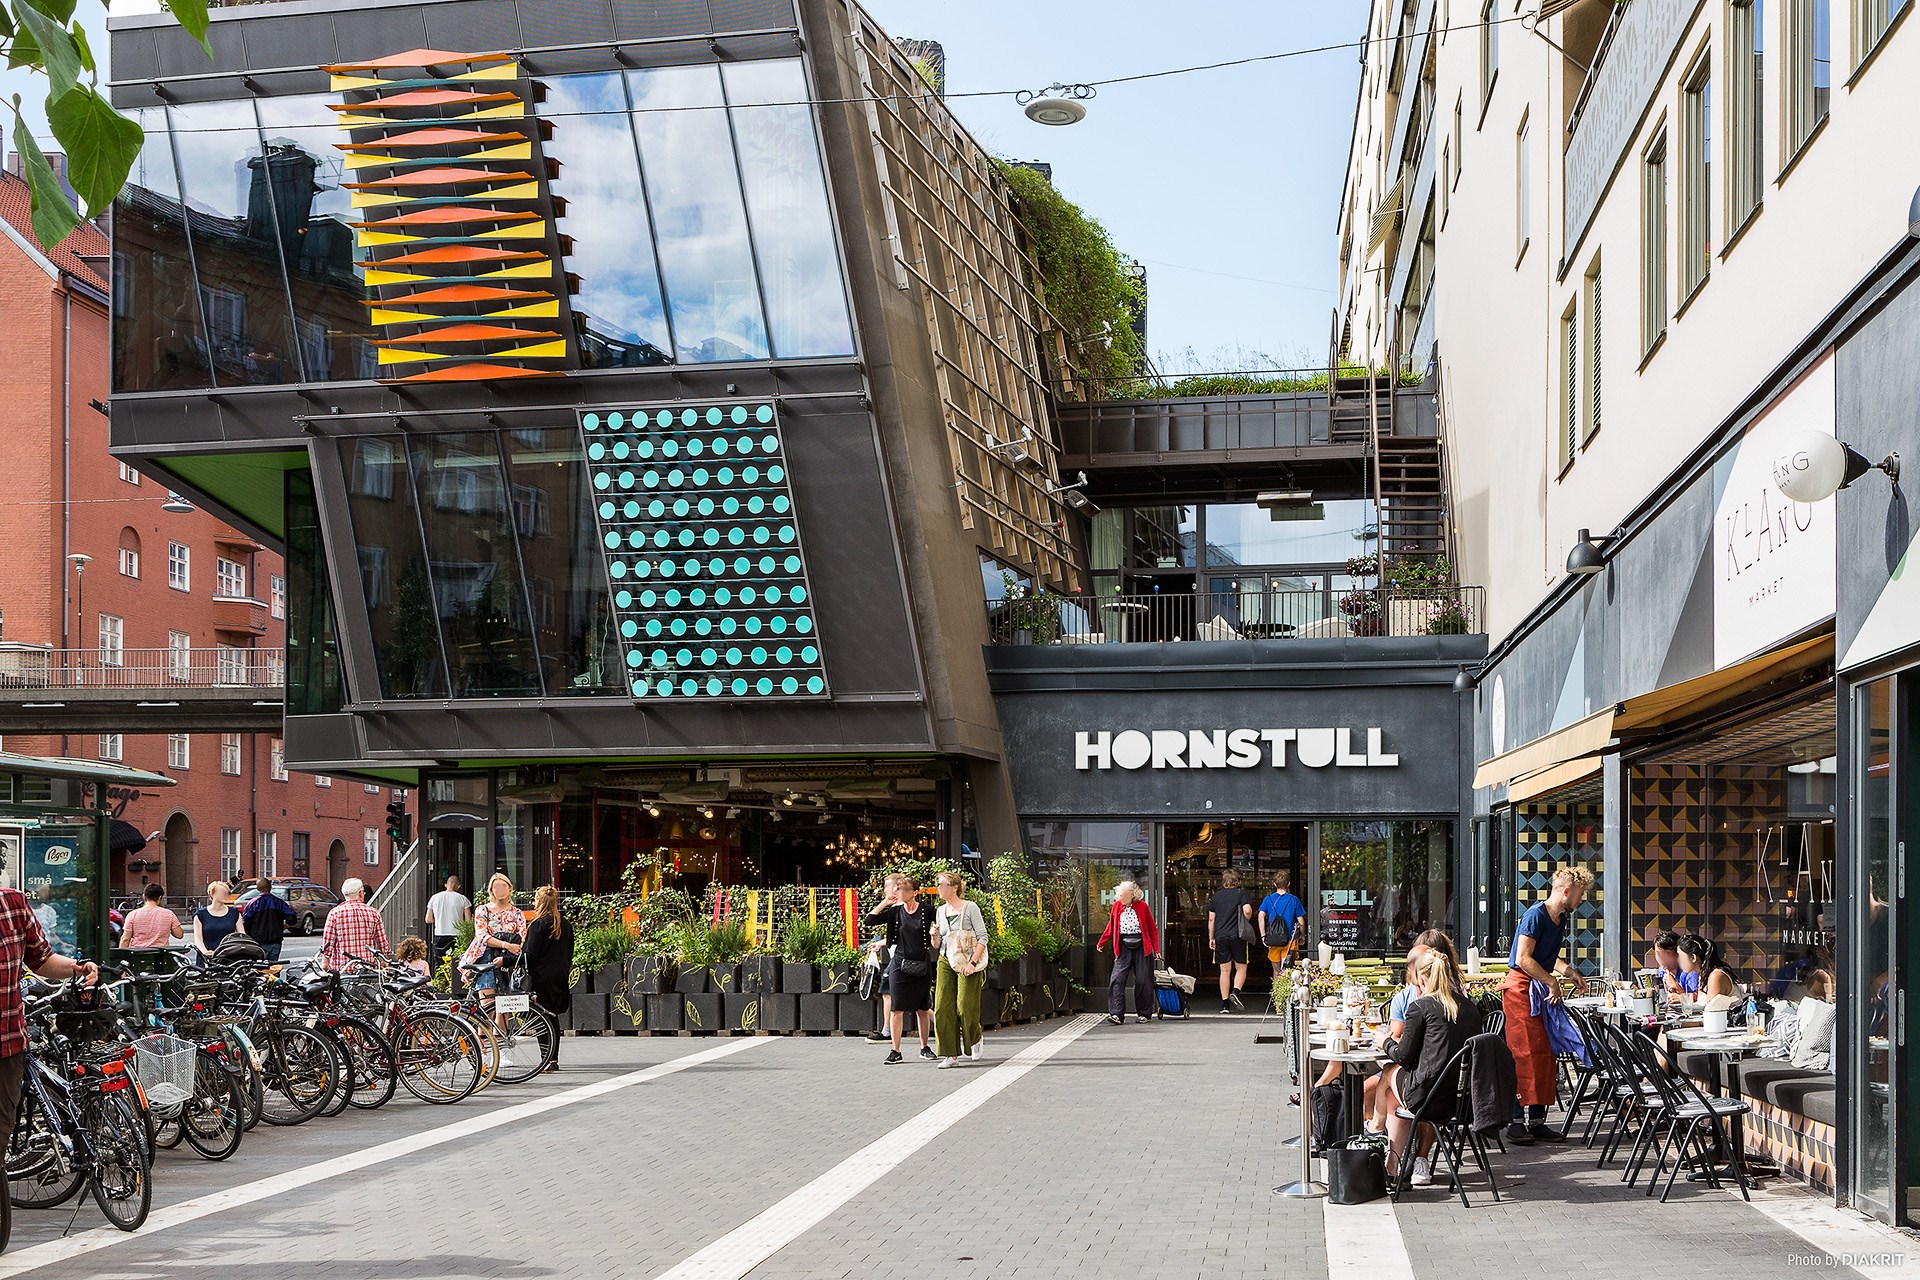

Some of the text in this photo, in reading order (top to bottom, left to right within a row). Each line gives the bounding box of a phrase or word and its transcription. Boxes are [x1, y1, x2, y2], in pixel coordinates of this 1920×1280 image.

[1074, 726, 1399, 770] HORNSTULL
[1756, 819, 1834, 903] KLAN
[27, 873, 52, 885] små
[1782, 929, 1827, 946] MARKET
